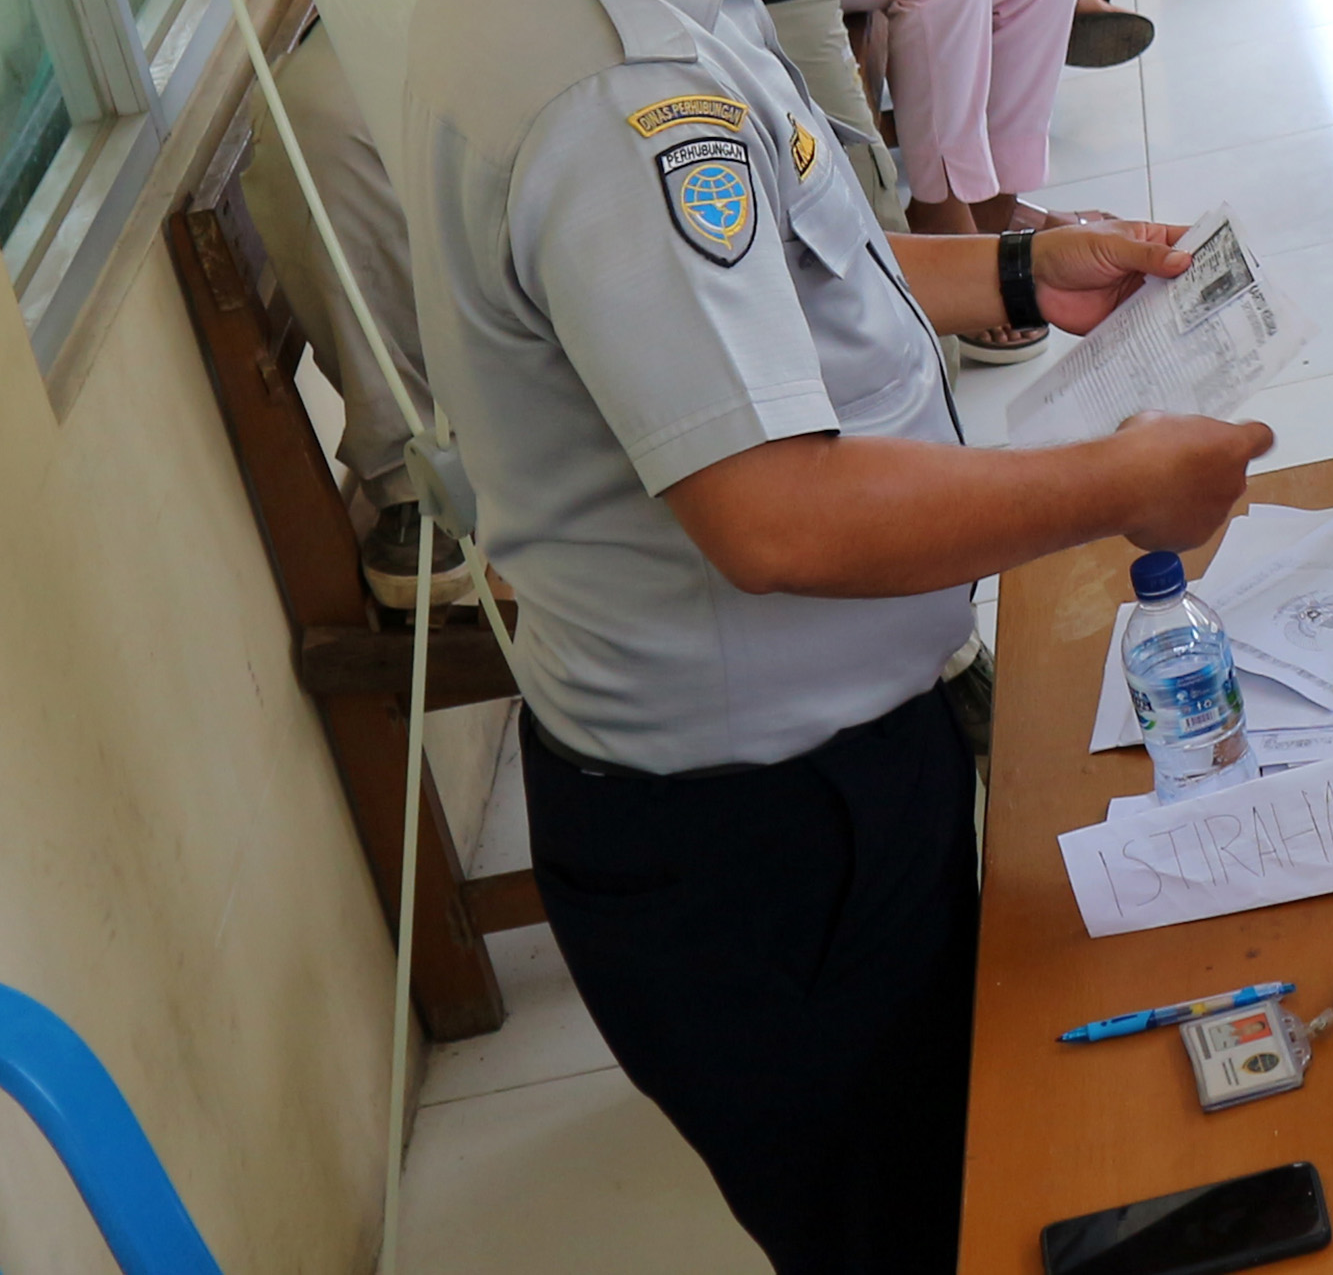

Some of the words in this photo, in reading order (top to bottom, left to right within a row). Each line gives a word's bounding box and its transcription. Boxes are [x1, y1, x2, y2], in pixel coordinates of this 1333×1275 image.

[639, 107, 673, 130] DINAS
[674, 101, 742, 127] PERHUBUNGAN
[665, 142, 743, 168] PERHUBUNGAN
